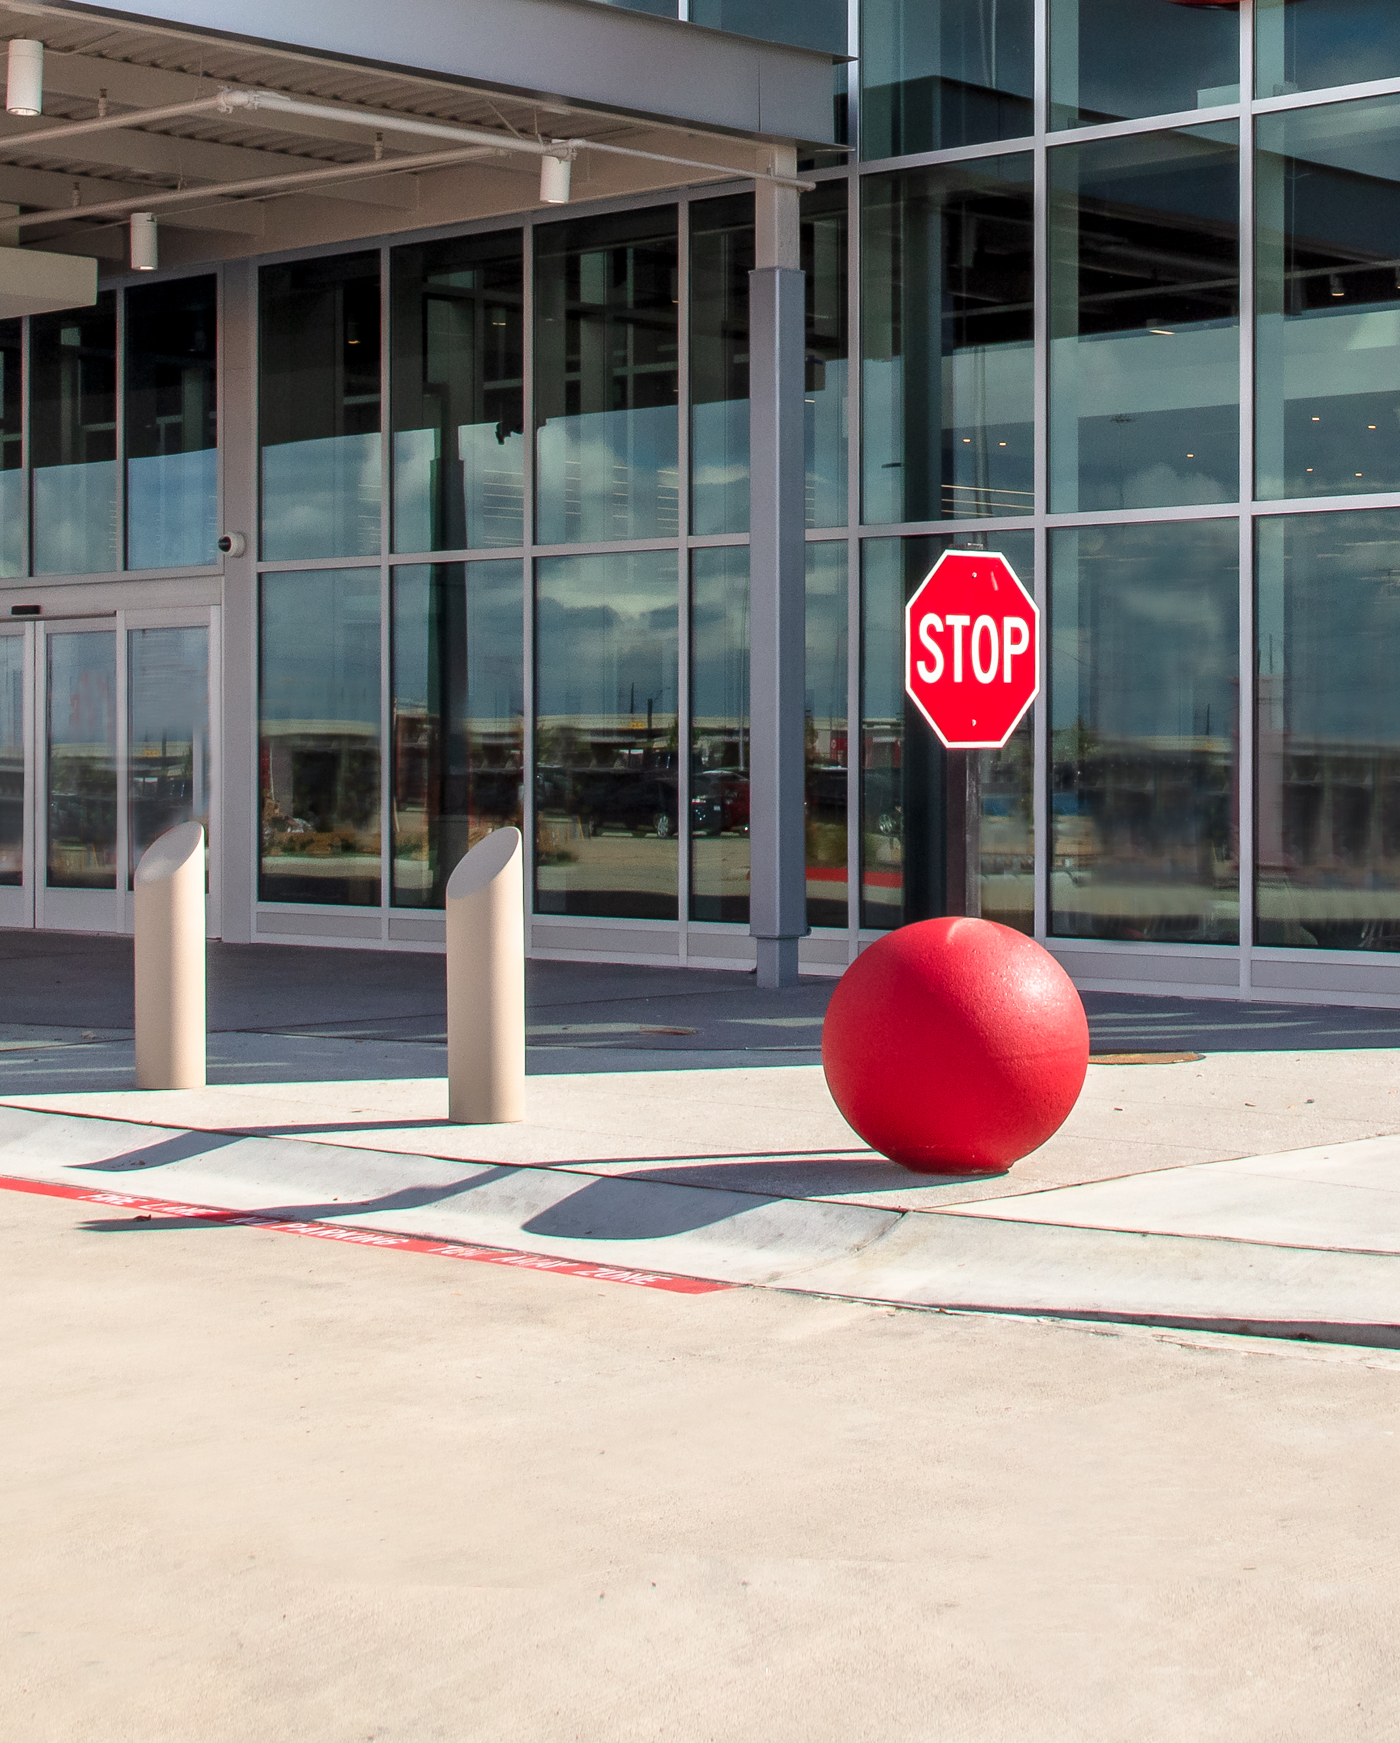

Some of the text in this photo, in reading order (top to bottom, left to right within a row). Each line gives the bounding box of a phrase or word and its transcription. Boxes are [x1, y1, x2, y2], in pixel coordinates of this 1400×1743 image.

[916, 612, 1030, 684] STOP
[138, 1202, 221, 1217] LANE
[270, 1222, 409, 1246] PARKING
[490, 1255, 580, 1269] AWAY
[572, 1267, 673, 1285] ZONE
